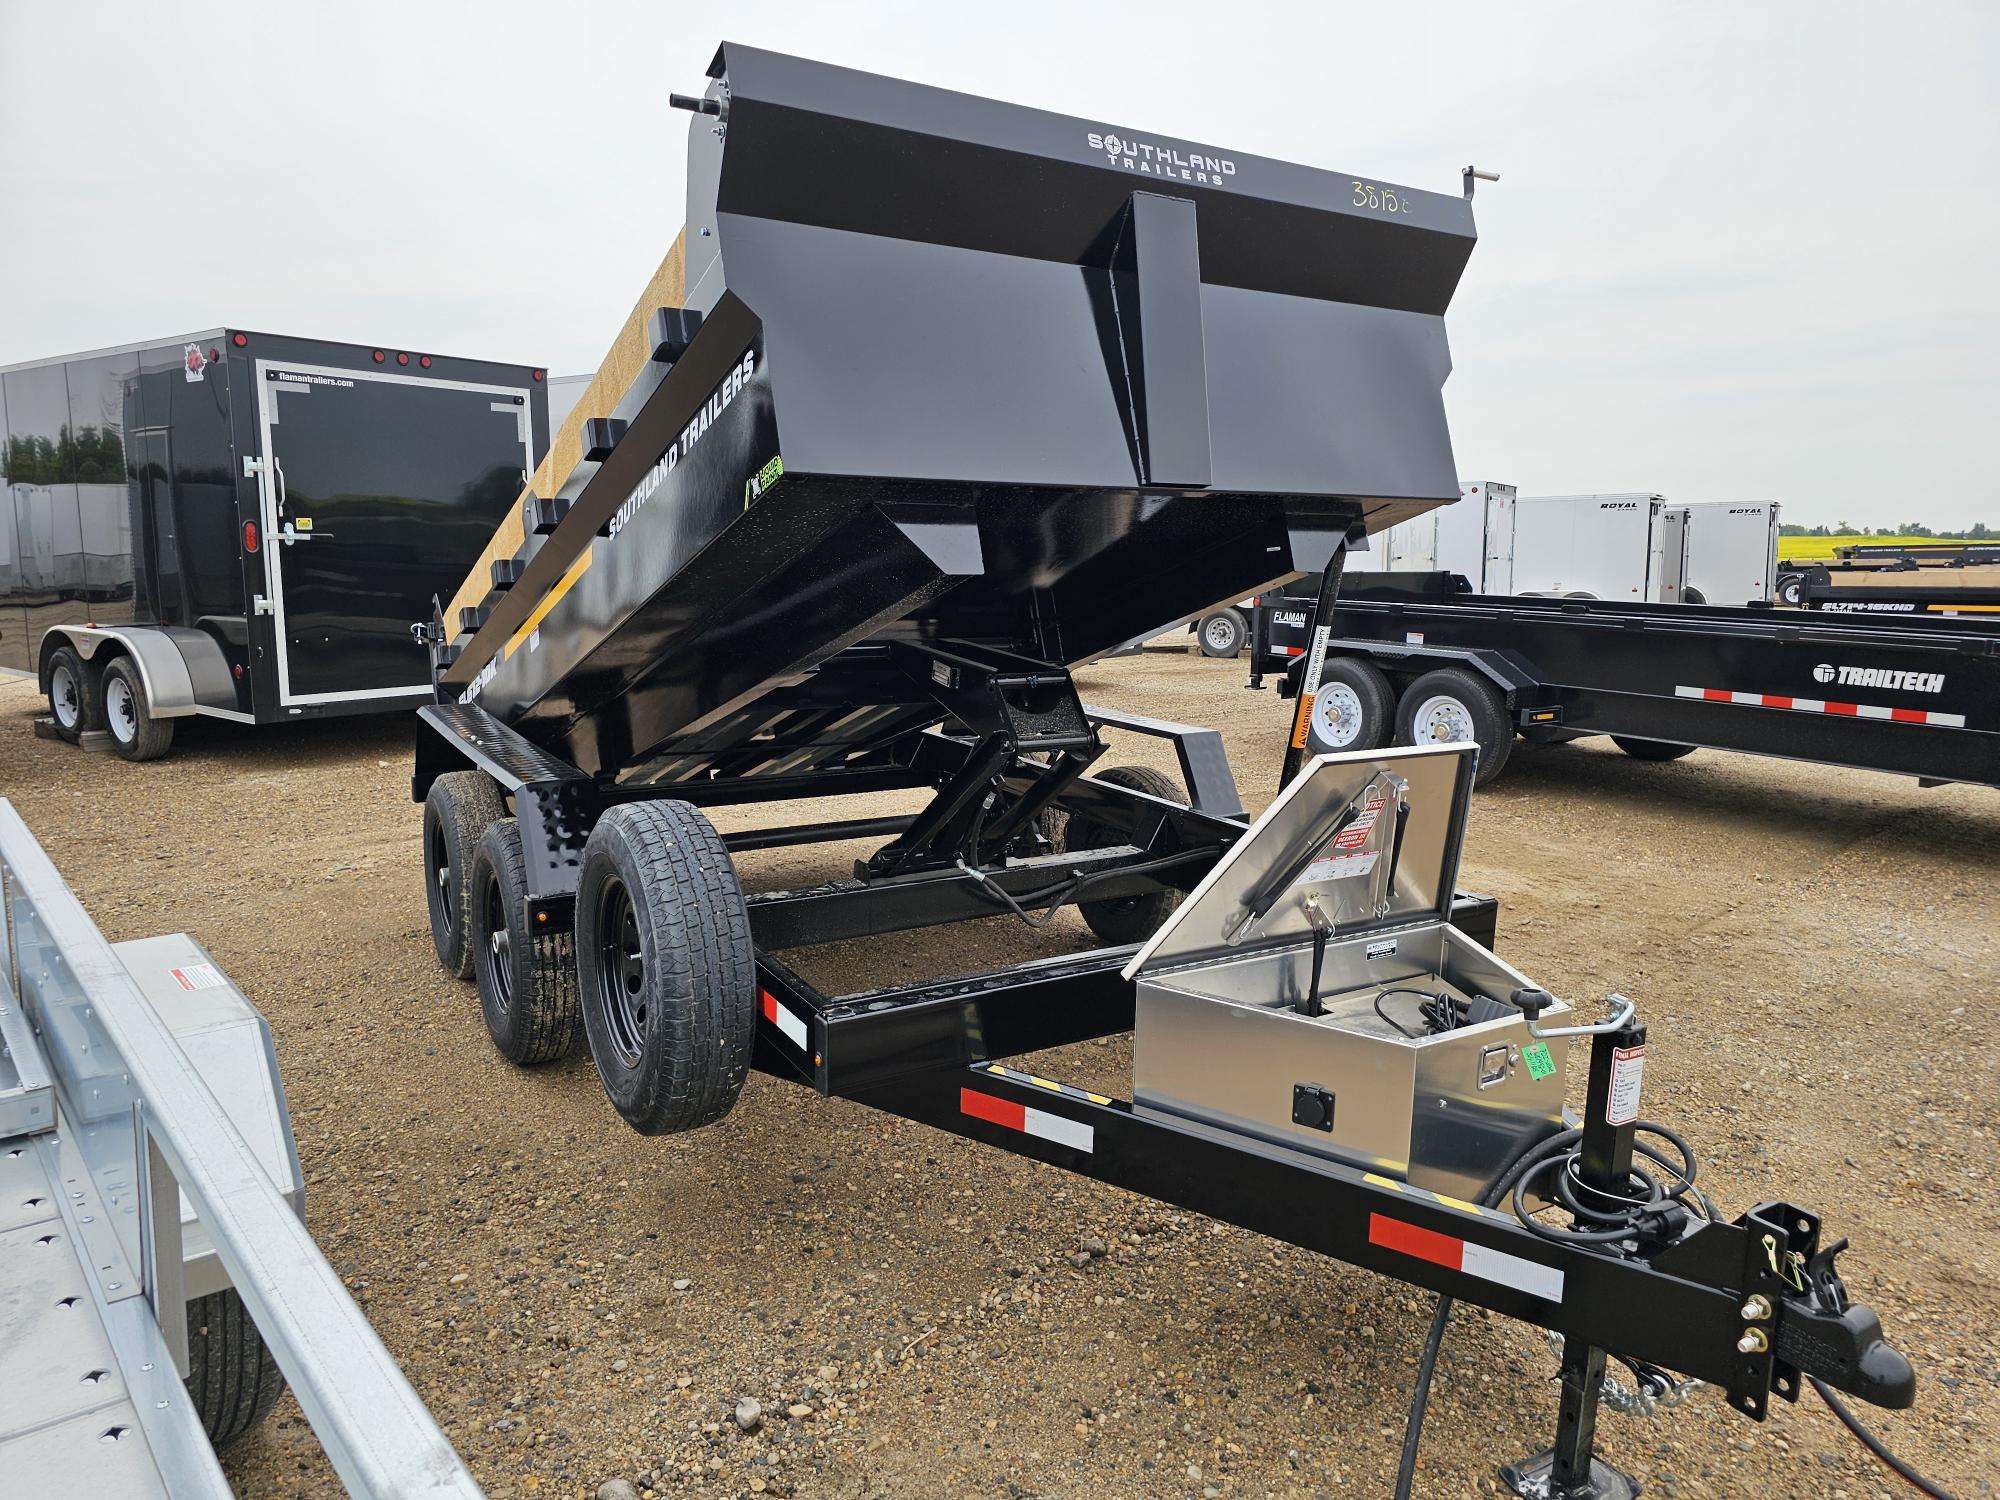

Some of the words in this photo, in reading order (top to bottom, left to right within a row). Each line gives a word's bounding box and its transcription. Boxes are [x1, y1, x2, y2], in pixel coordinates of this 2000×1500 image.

[1087, 133, 1236, 175] SOUTHLAND
[1107, 154, 1223, 186] TRAILERS
[279, 372, 354, 388] flamantrailers.com
[608, 442, 678, 541] SOUTHLAND
[681, 350, 754, 456] TRAILERS
[1273, 611, 1307, 623] FLAMAN
[1318, 628, 1326, 649] EMPTY
[1837, 665, 1946, 693] TRAILTECH
[1301, 696, 1315, 735] WARNING
